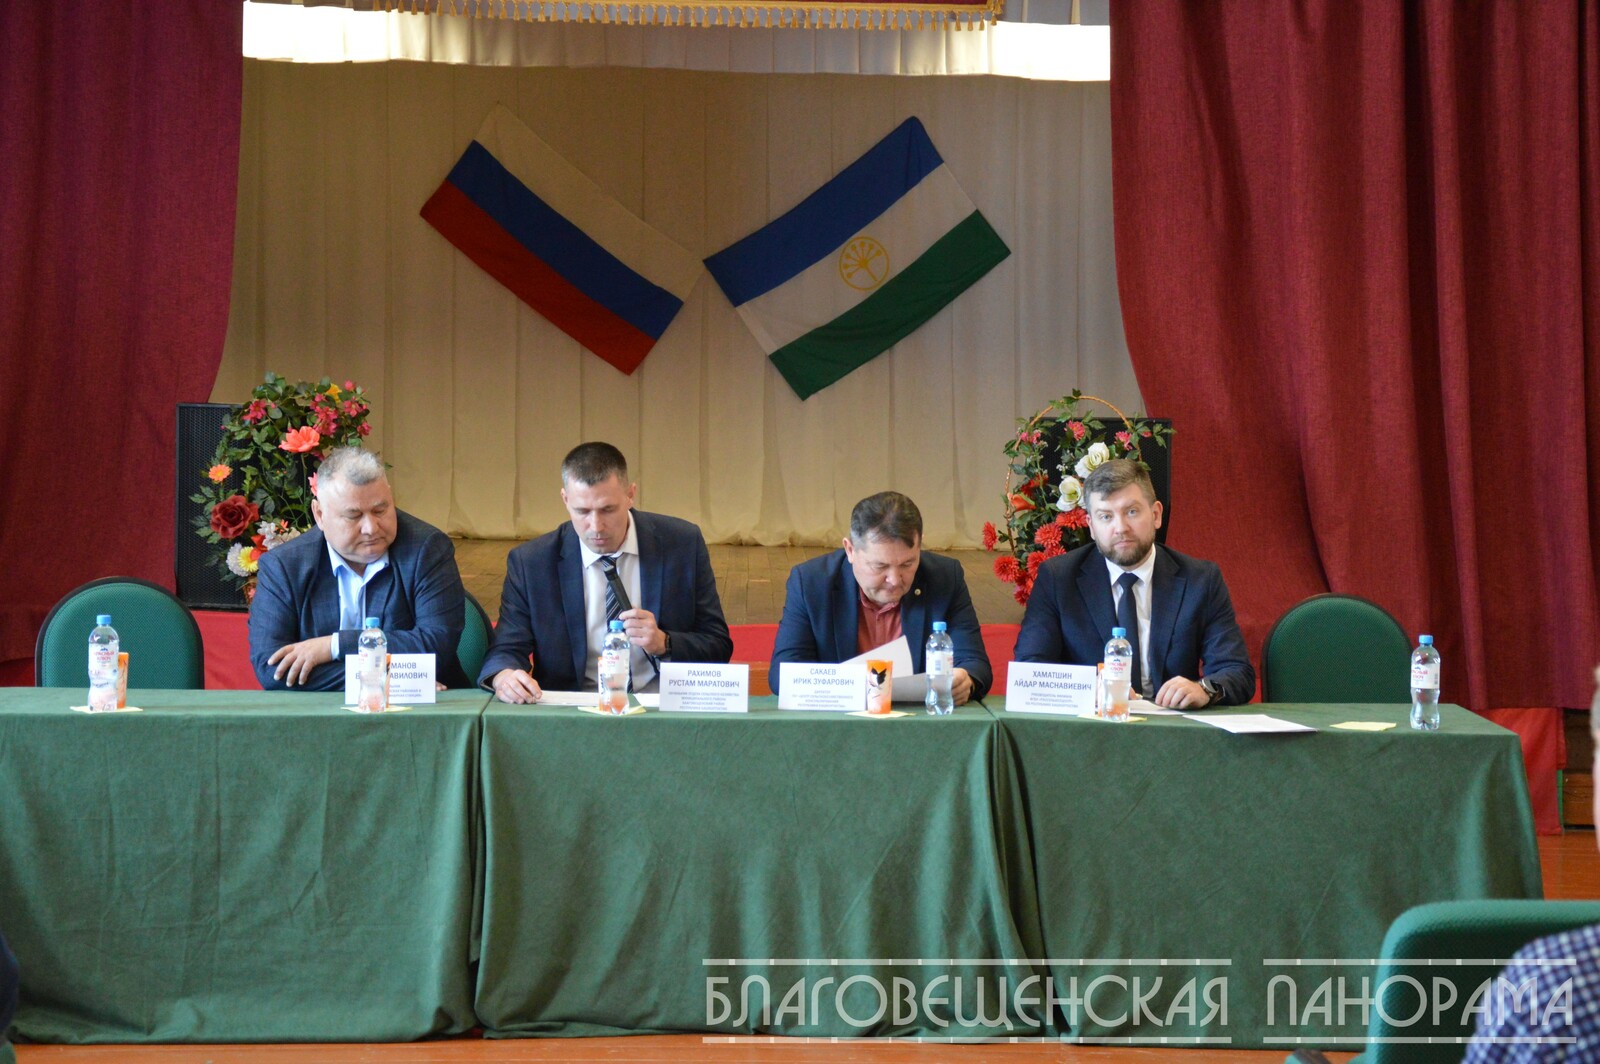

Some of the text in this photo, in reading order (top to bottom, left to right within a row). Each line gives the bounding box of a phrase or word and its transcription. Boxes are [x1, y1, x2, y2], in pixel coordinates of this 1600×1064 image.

[390, 662, 417, 670] МАНОВ
[390, 672, 428, 680] АВИЛОВИЧ
[687, 669, 722, 678] РАХИМОВ
[809, 668, 837, 676] САКАЕВ
[1032, 670, 1073, 680] ХАМАТШИН
[668, 679, 740, 688] РУСТАМ МАРАТОВИЧ
[793, 677, 855, 686] ИРИК ЗУФАРОВИЧ
[1013, 678, 1092, 691] АЙДАР МАСНАВИЕВИЧ
